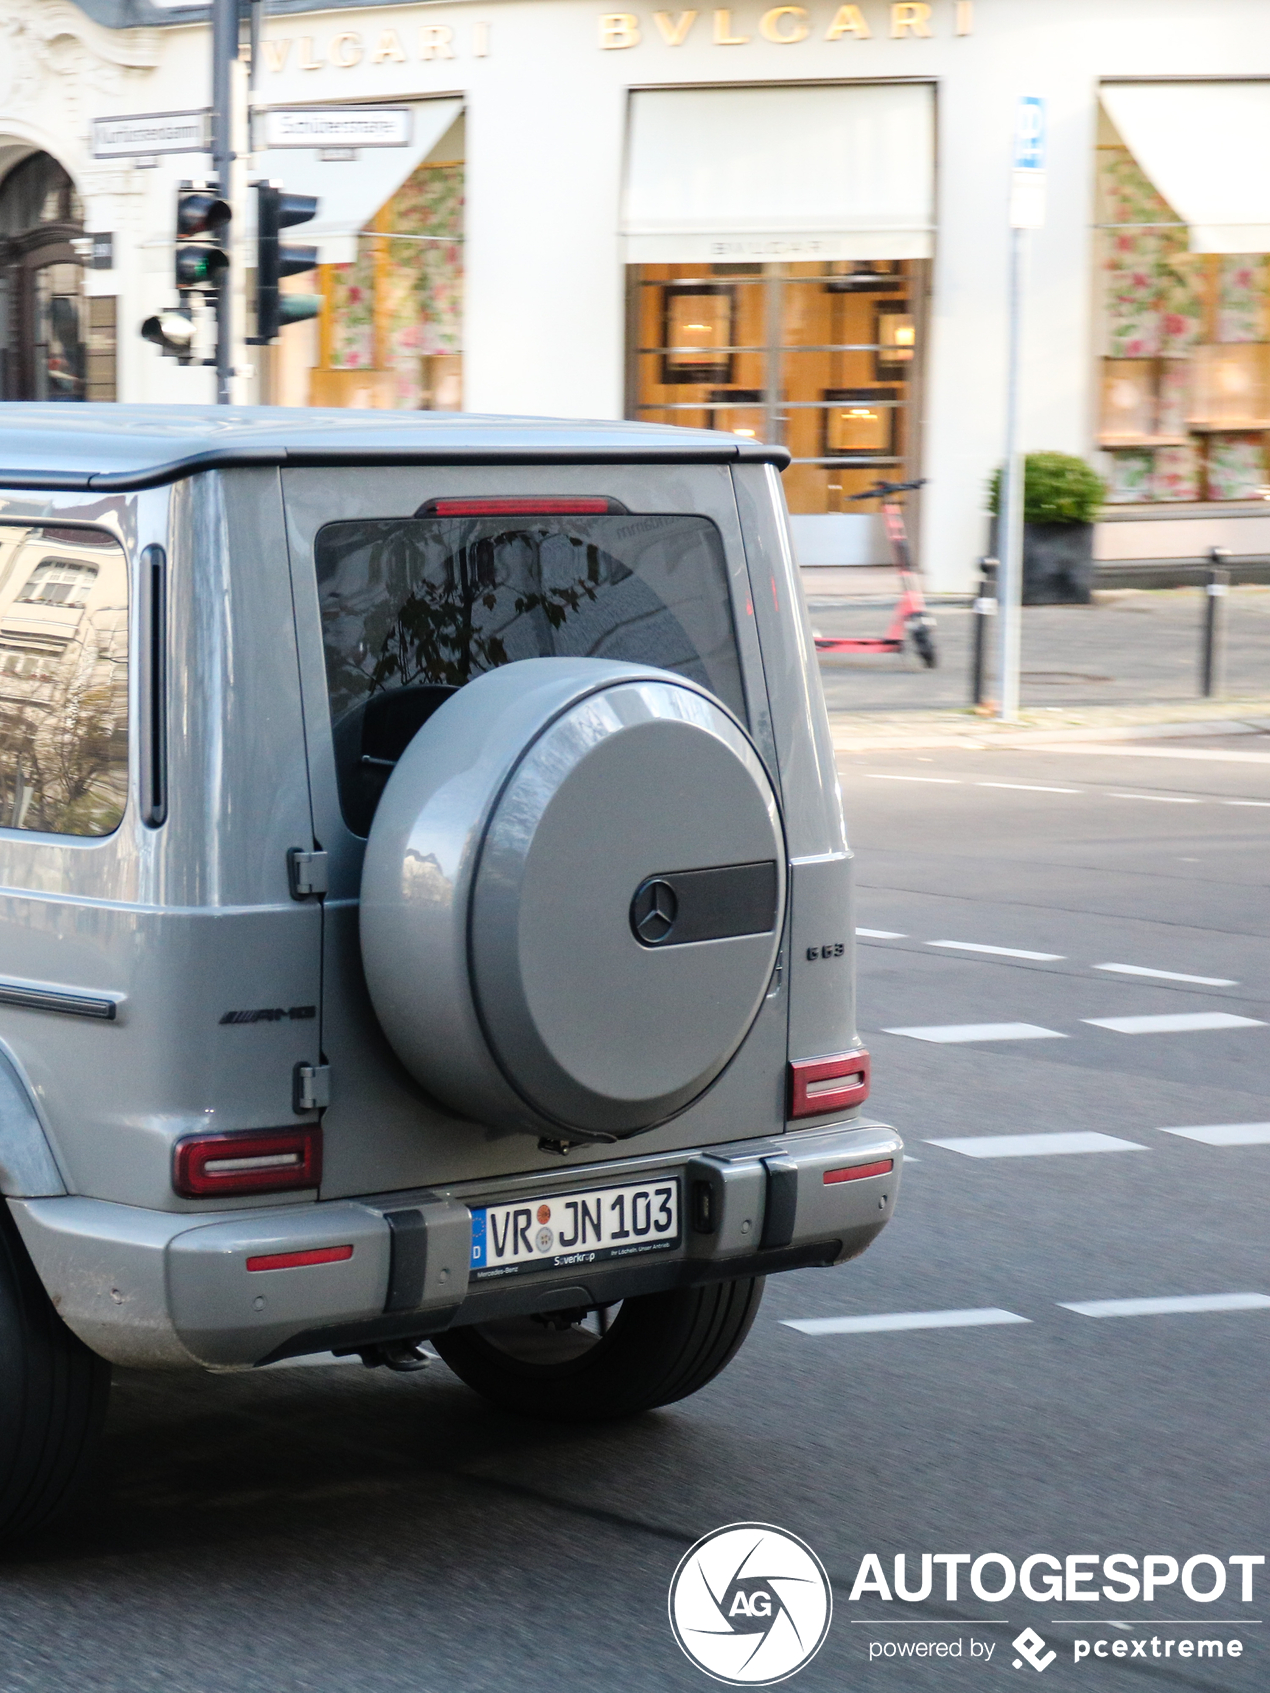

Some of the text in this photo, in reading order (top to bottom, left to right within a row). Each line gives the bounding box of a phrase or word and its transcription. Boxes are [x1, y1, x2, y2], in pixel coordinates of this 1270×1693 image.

[599, 1, 973, 50] BVLGARI
[491, 1208, 533, 1257] VR
[559, 1198, 602, 1247] JN
[611, 1187, 673, 1240] 103
